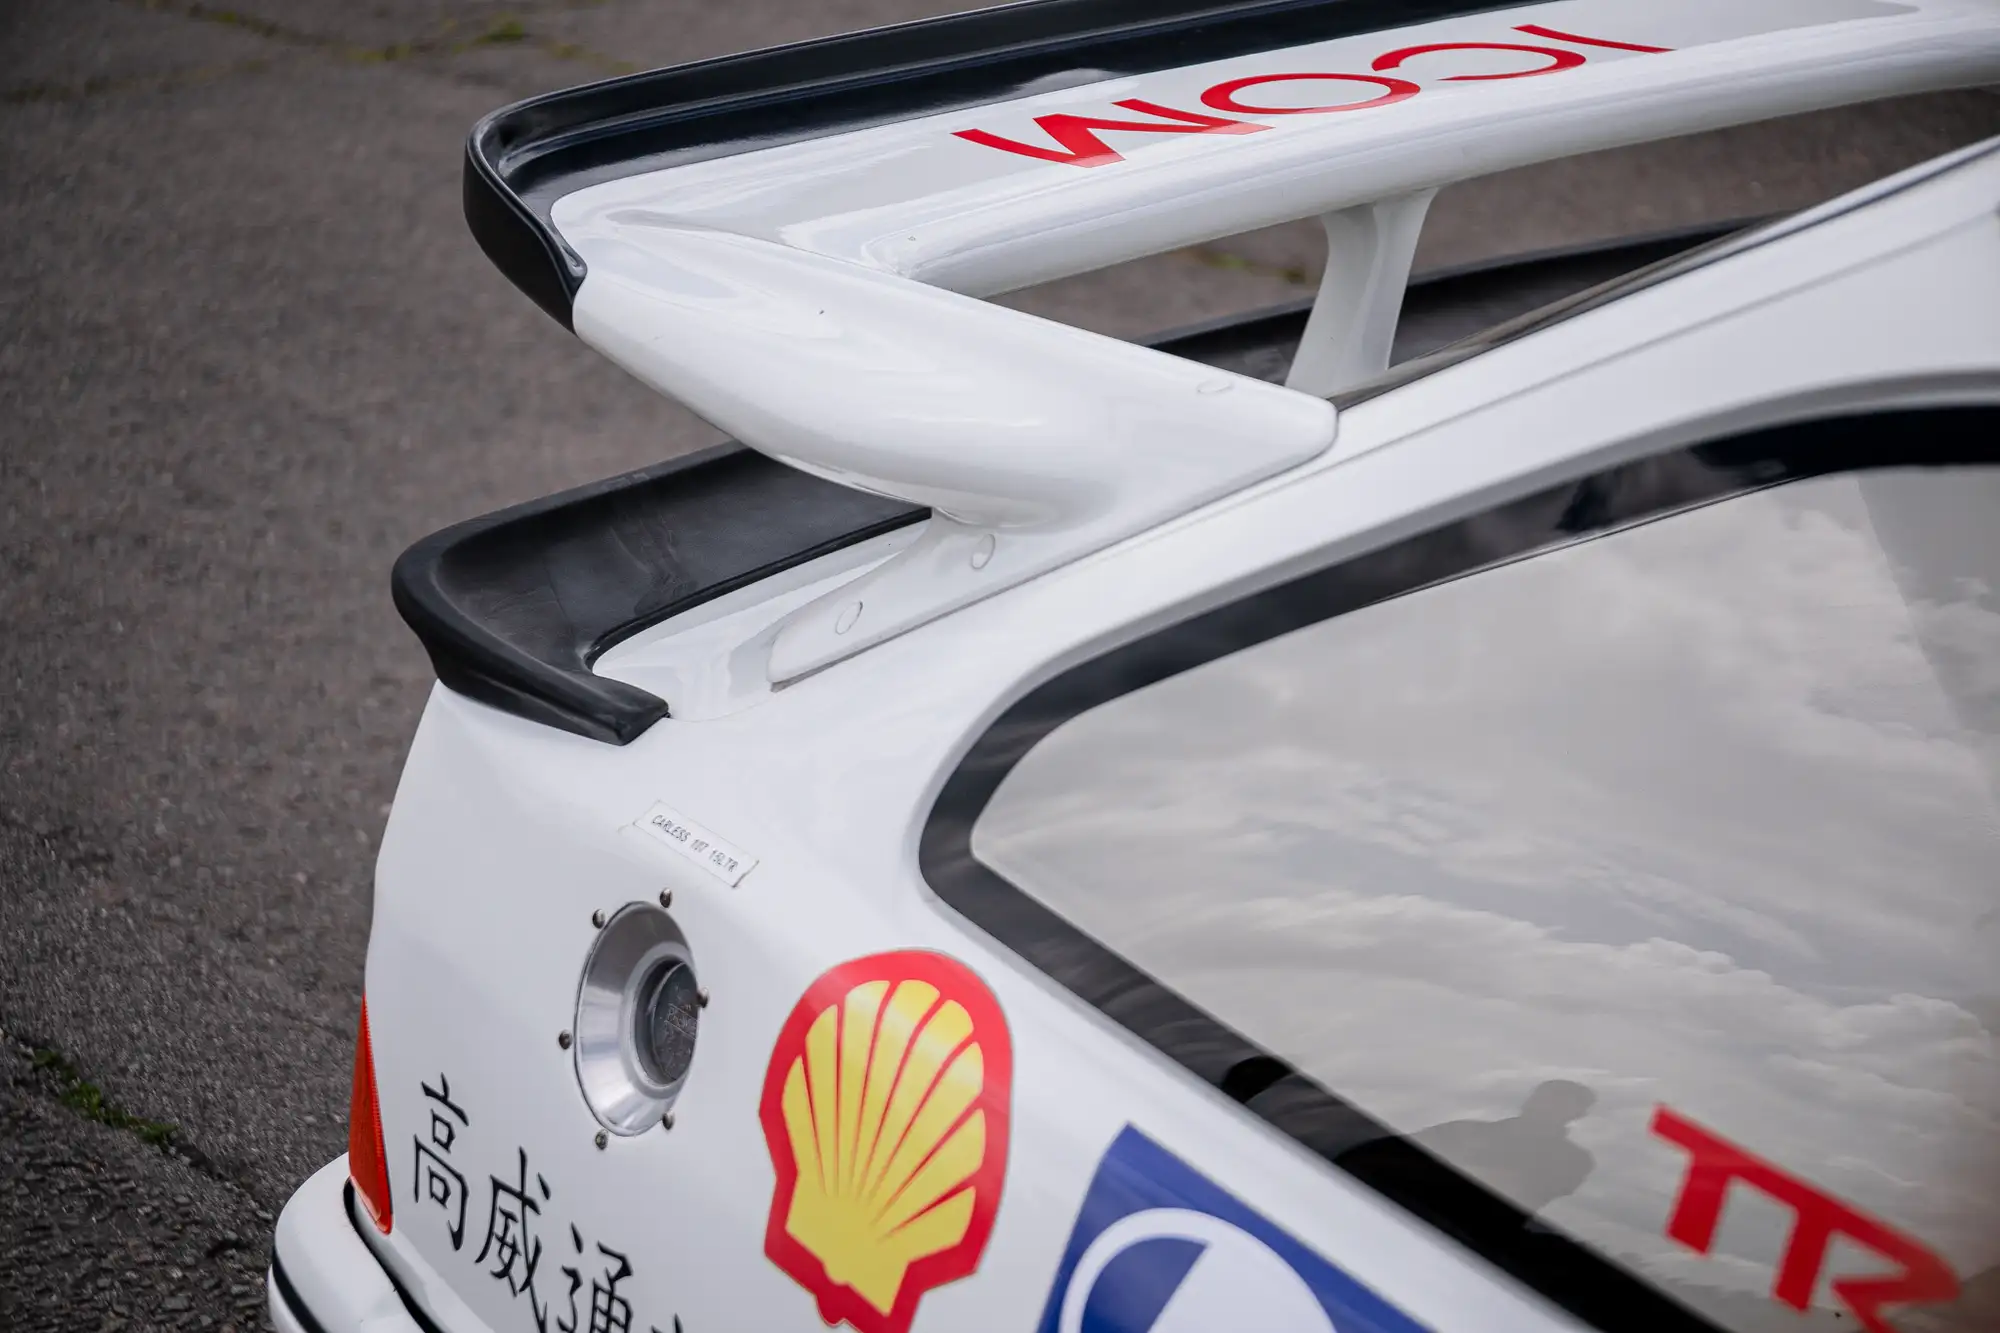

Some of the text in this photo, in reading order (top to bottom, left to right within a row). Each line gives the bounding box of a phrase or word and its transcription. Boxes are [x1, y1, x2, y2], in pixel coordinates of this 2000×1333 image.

[951, 24, 1675, 168] ICOM
[651, 814, 691, 842] CARLESS
[413, 1072, 684, 1333] 高威通
